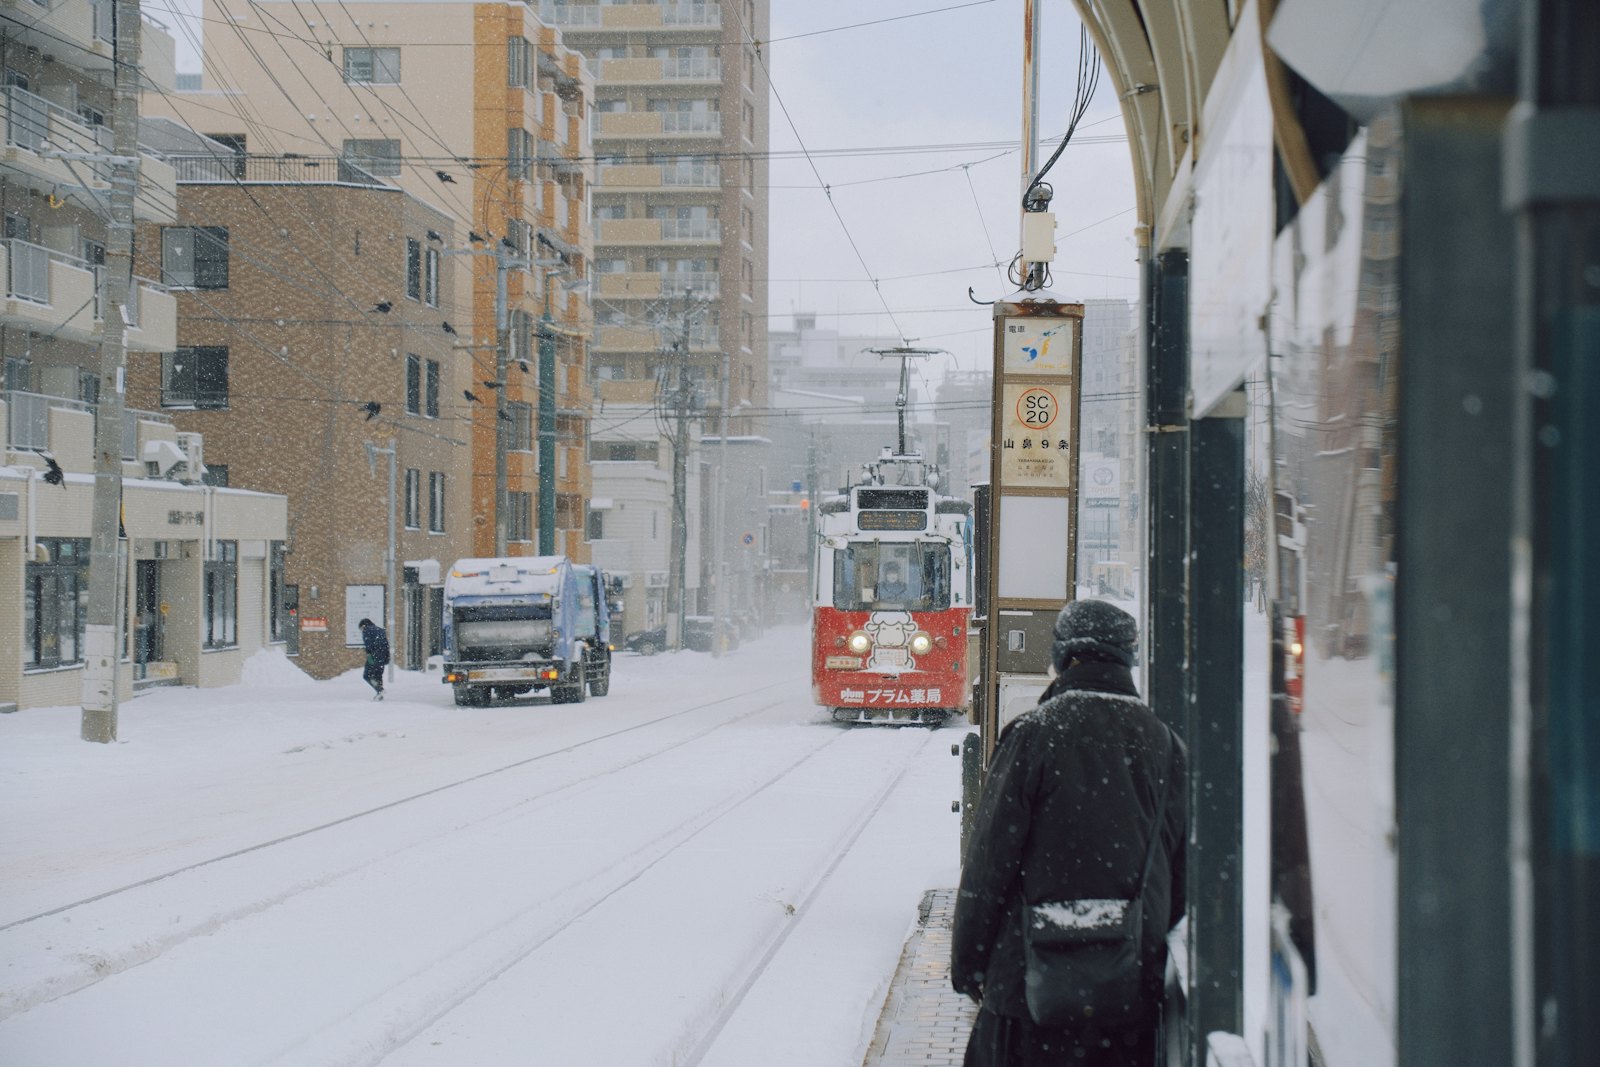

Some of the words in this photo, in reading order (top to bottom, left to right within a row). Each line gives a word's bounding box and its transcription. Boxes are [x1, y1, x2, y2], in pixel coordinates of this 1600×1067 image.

[1026, 395, 1049, 409] SC
[1026, 410, 1049, 424] 20
[867, 688, 941, 704] プラム薬局
